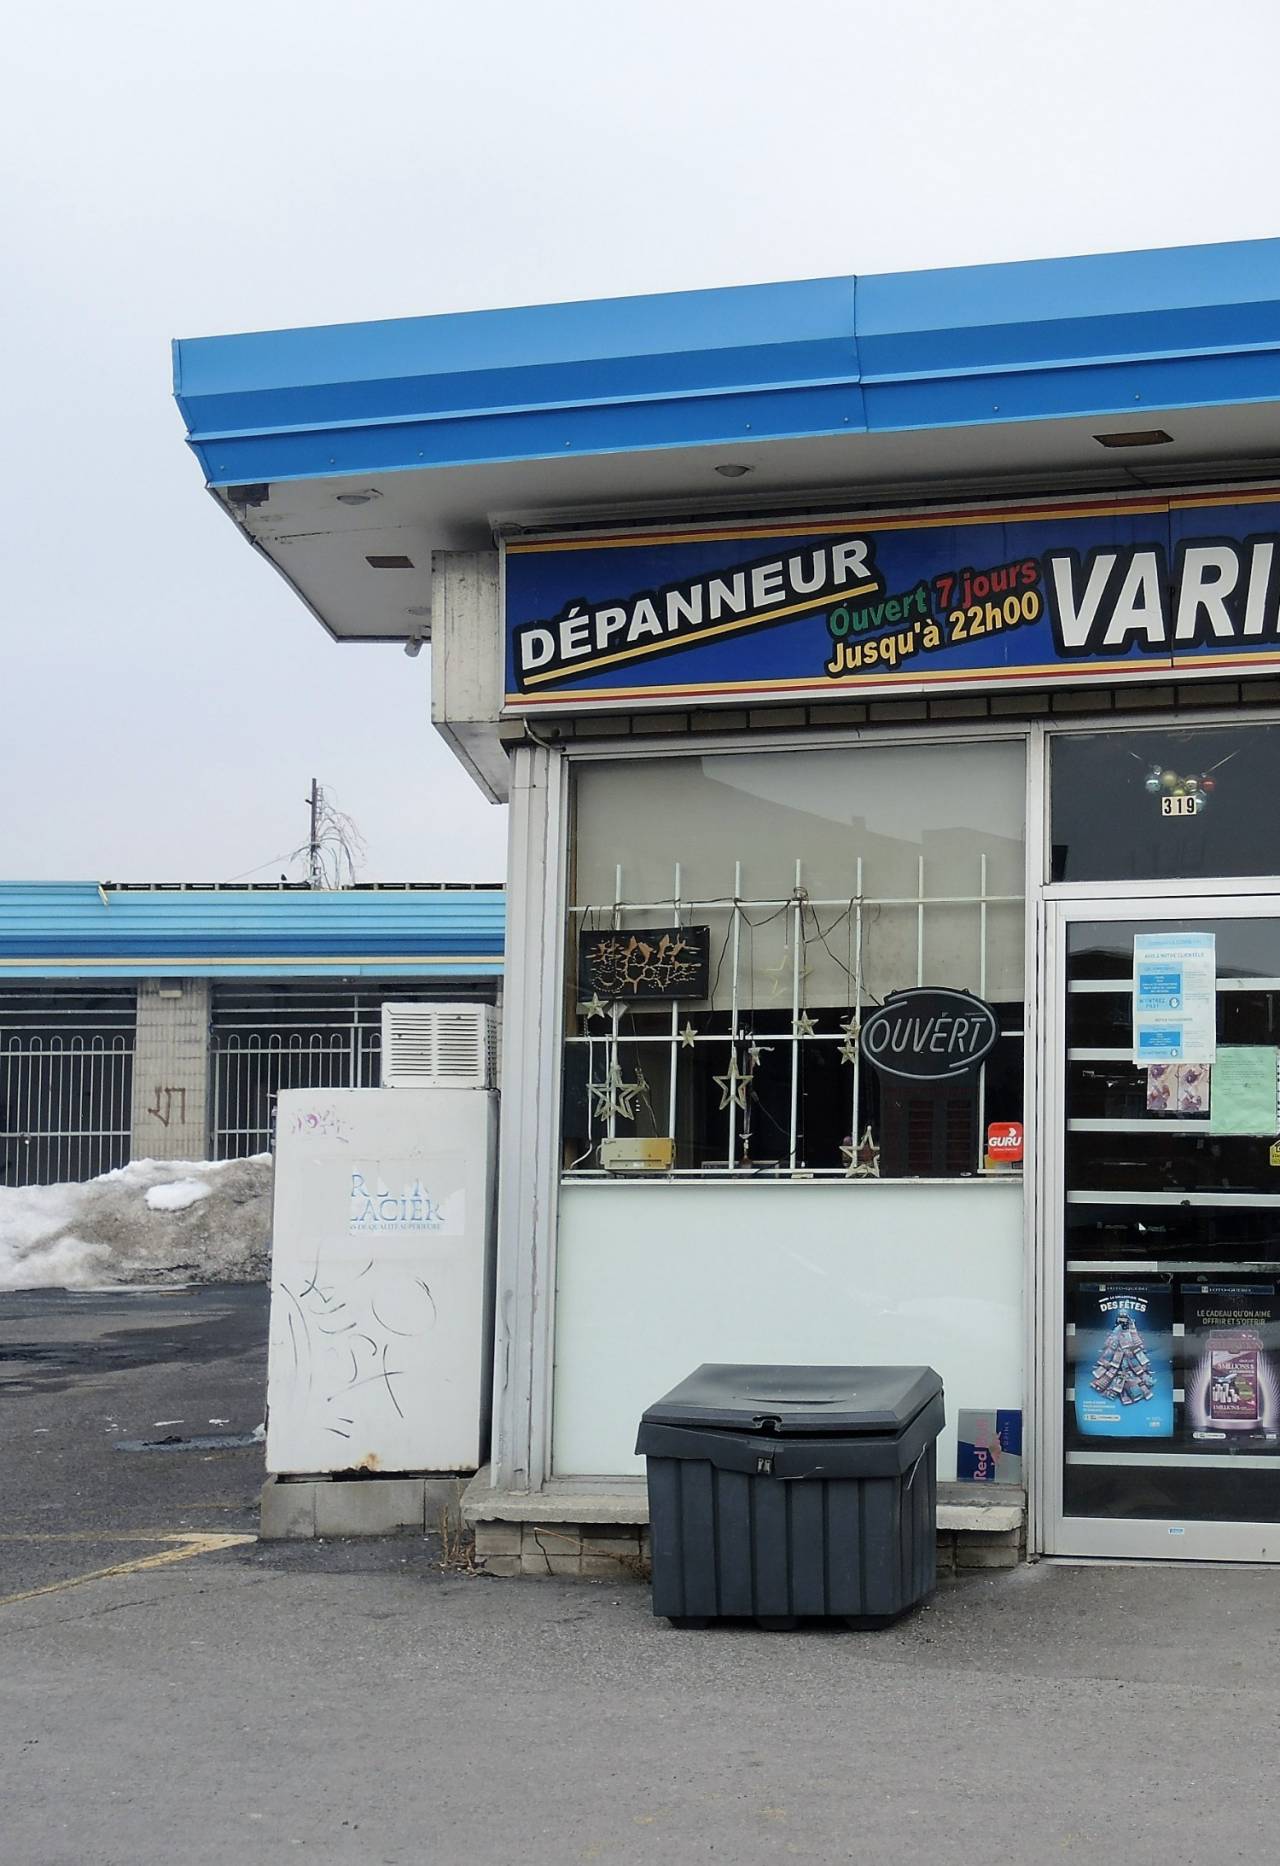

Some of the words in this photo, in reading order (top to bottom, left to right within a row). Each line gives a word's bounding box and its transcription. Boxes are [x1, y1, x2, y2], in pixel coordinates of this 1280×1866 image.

[520, 539, 872, 671] DÉPANNEUR
[829, 586, 928, 637] Ouvert
[936, 577, 954, 609] 7
[961, 559, 1038, 610] jours
[828, 618, 941, 673] Jusqu'à
[949, 590, 1039, 642] 22h00
[1163, 796, 1195, 815] 319
[988, 1136, 1022, 1147] GURU
[1100, 1301, 1118, 1312] DES
[1119, 1299, 1147, 1312] FÊTES
[1196, 1309, 1205, 1318] LE
[1205, 1309, 1232, 1318] CADEAU
[1232, 1309, 1254, 1318] QU'ON
[1254, 1310, 1272, 1318] AIME
[1202, 1317, 1227, 1325] OFFRIR
[1235, 1317, 1266, 1326] S'OFFRIR
[973, 1450, 988, 1481] Red
